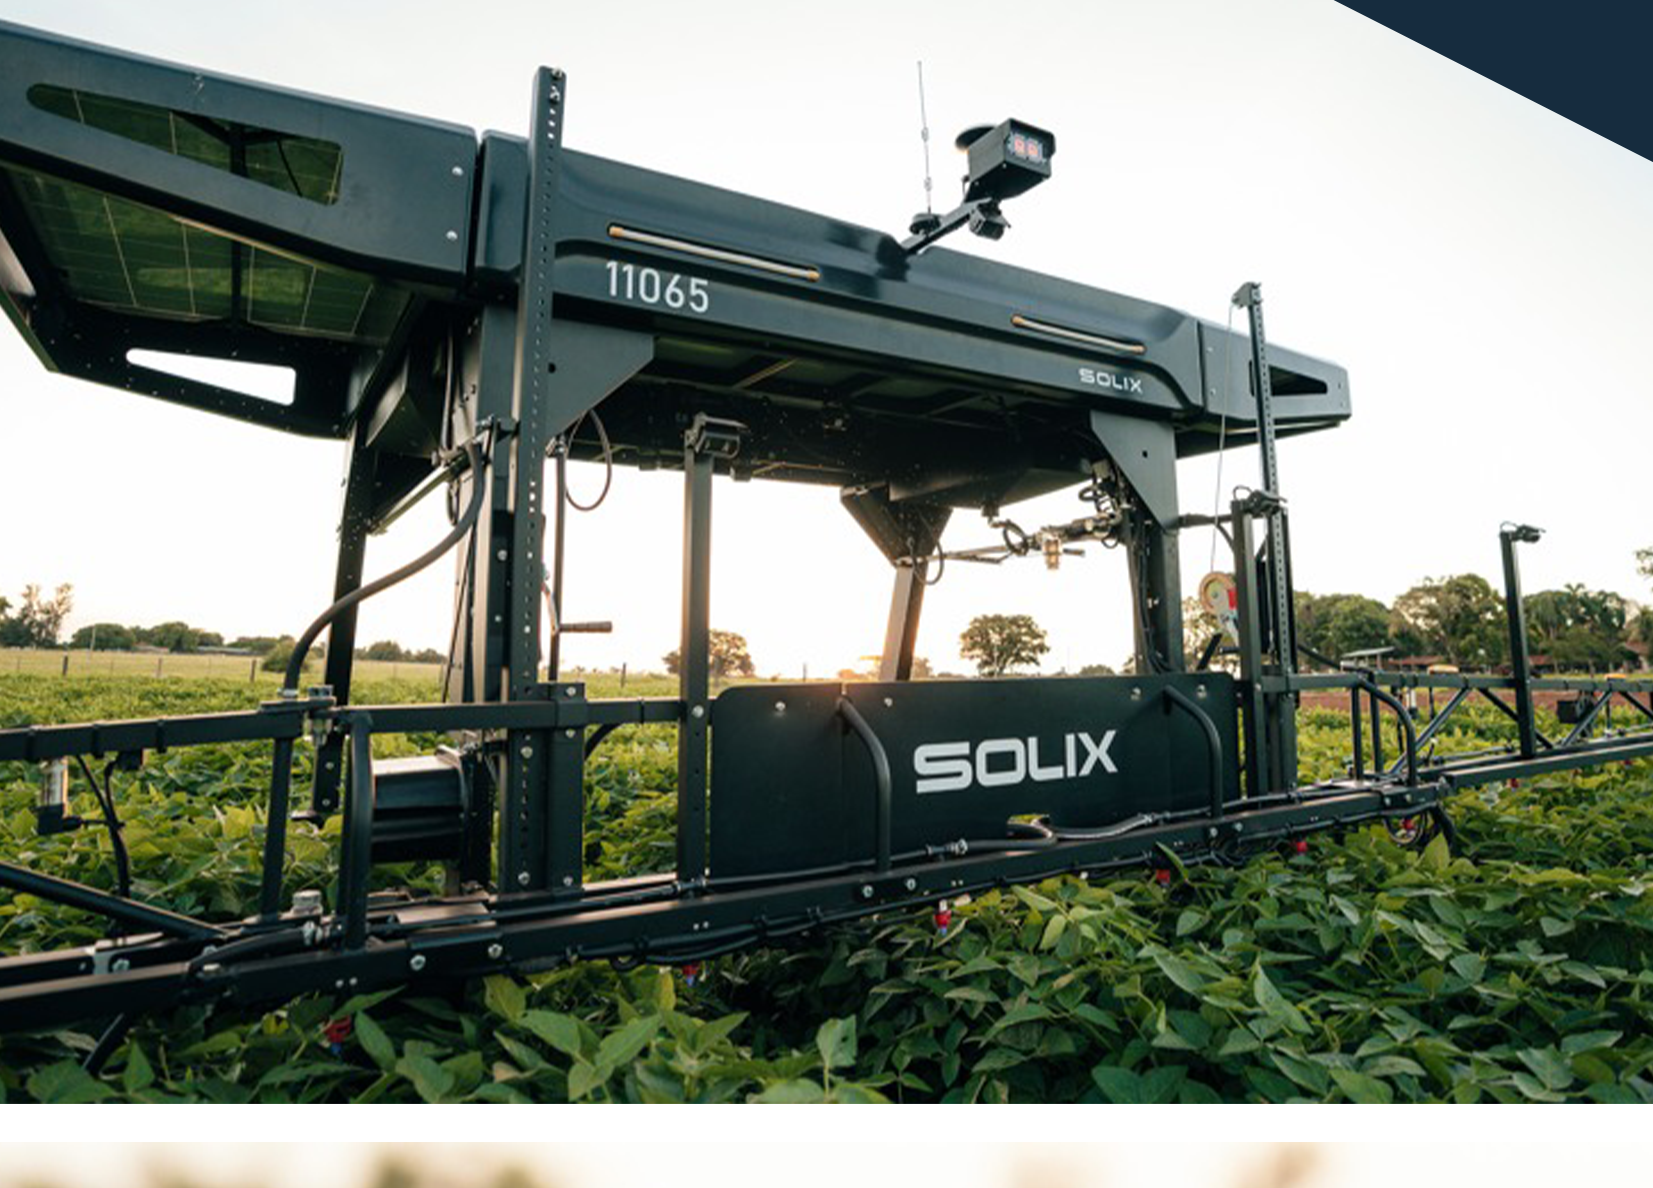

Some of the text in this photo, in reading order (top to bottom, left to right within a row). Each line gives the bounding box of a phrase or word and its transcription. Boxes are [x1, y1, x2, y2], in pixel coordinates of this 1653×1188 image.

[606, 260, 709, 313] 11065
[1078, 367, 1143, 395] SOLIX
[913, 729, 1119, 794] SOLIX
